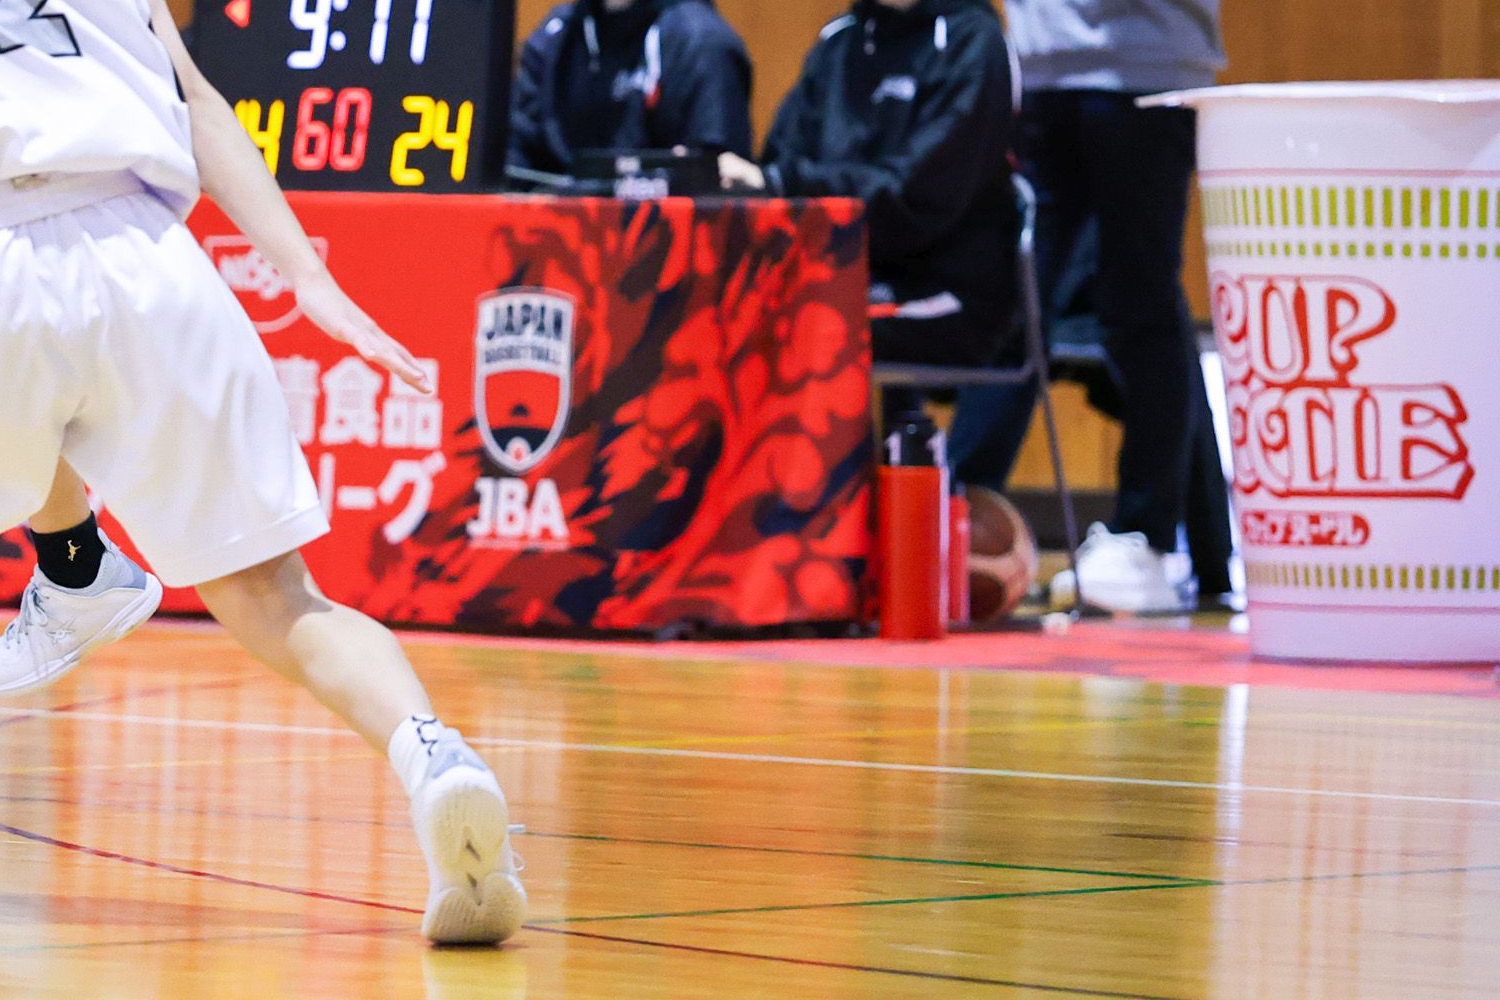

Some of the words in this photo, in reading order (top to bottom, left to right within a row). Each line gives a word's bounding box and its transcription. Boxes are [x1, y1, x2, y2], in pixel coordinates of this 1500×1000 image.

[292, 86, 373, 171] 60
[390, 95, 474, 187] 24
[466, 476, 570, 538] JBA
